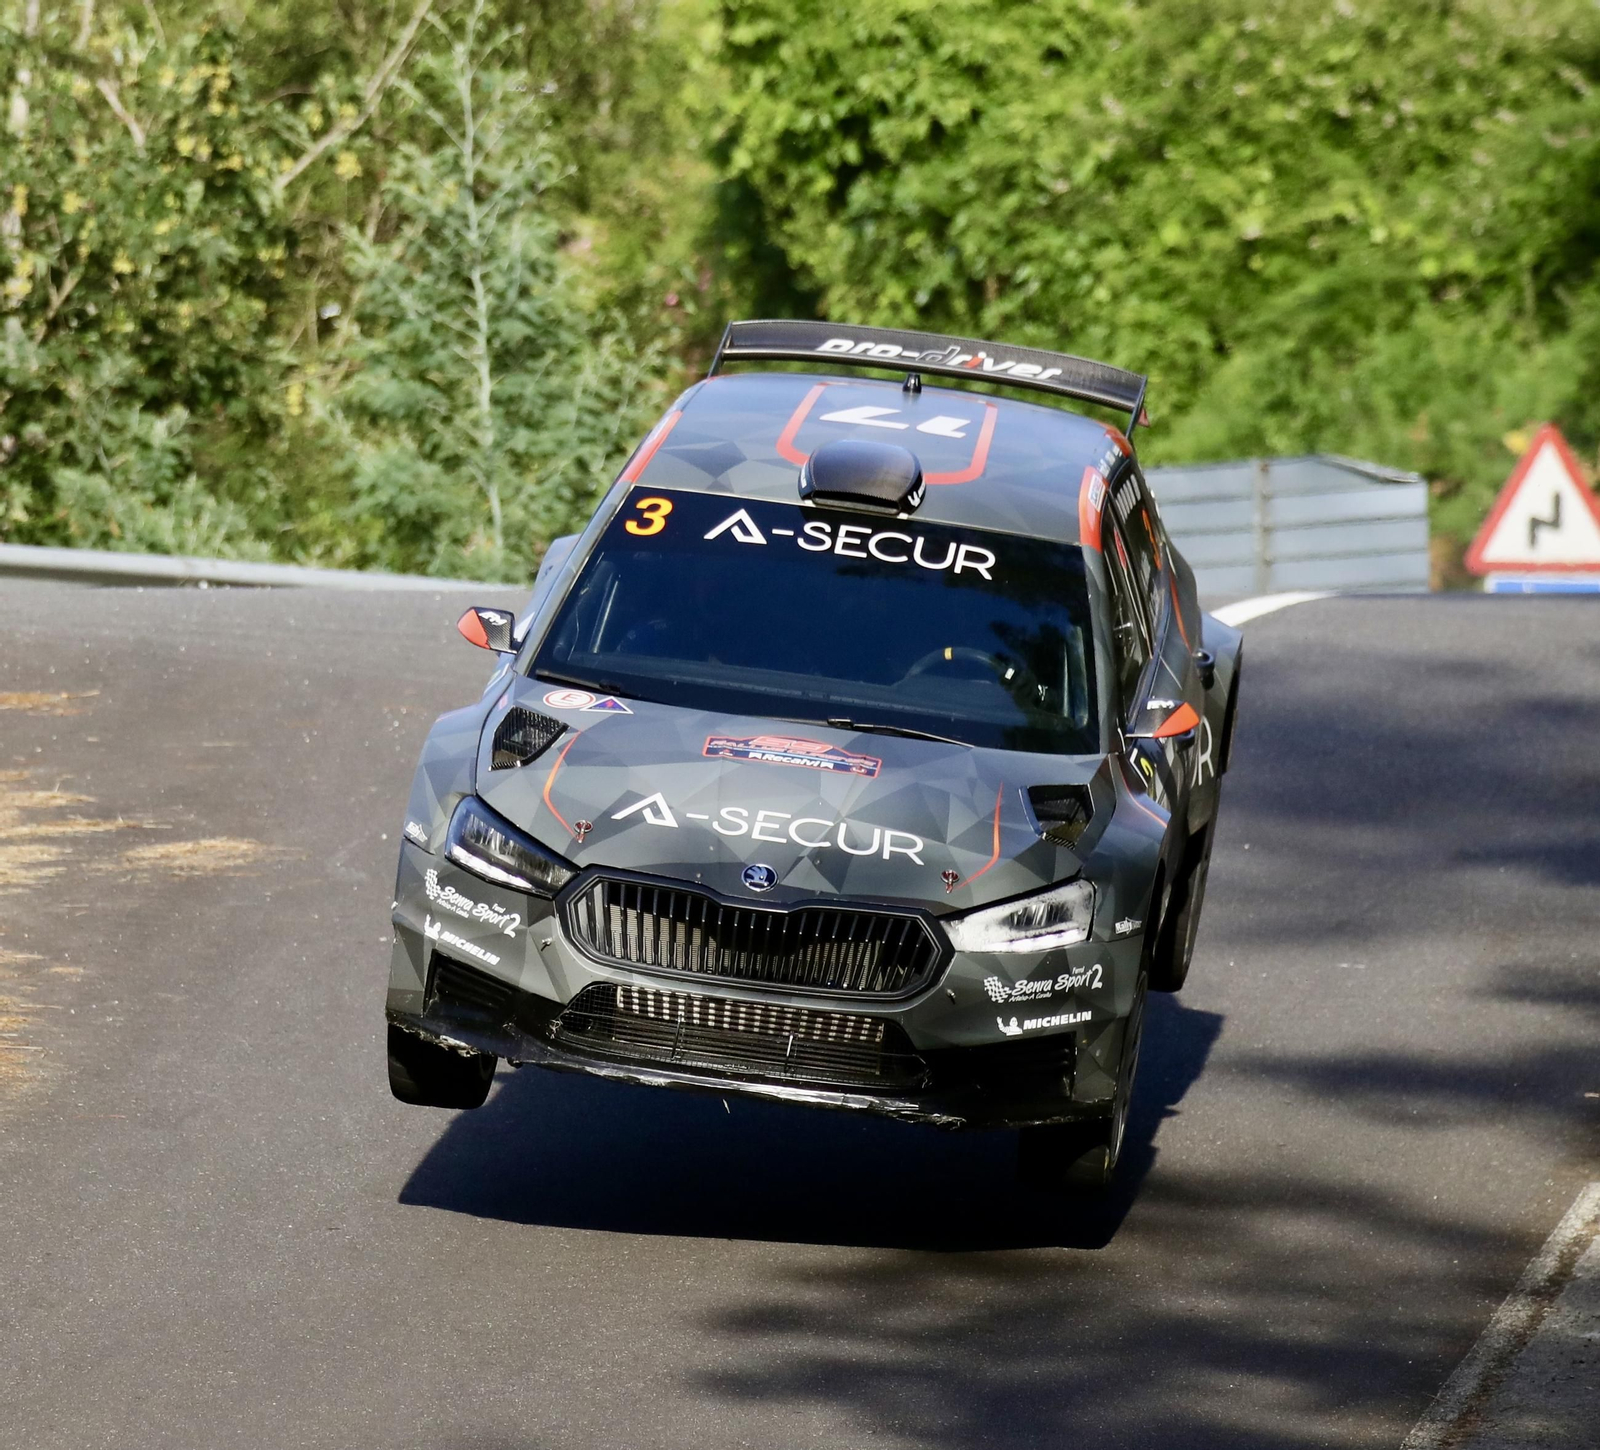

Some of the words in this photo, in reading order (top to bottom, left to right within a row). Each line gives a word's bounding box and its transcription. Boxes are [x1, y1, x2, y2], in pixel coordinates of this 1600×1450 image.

[816, 338, 1062, 381] pro-driver
[624, 496, 674, 537] 3
[440, 886, 474, 911] Senra
[472, 903, 510, 929] Sport
[440, 931, 500, 965] MICHELIN
[1011, 979, 1053, 995] Senra
[1054, 968, 1093, 993] Sport
[1091, 963, 1103, 990] 2
[1023, 1011, 1092, 1030] MICHELIN
